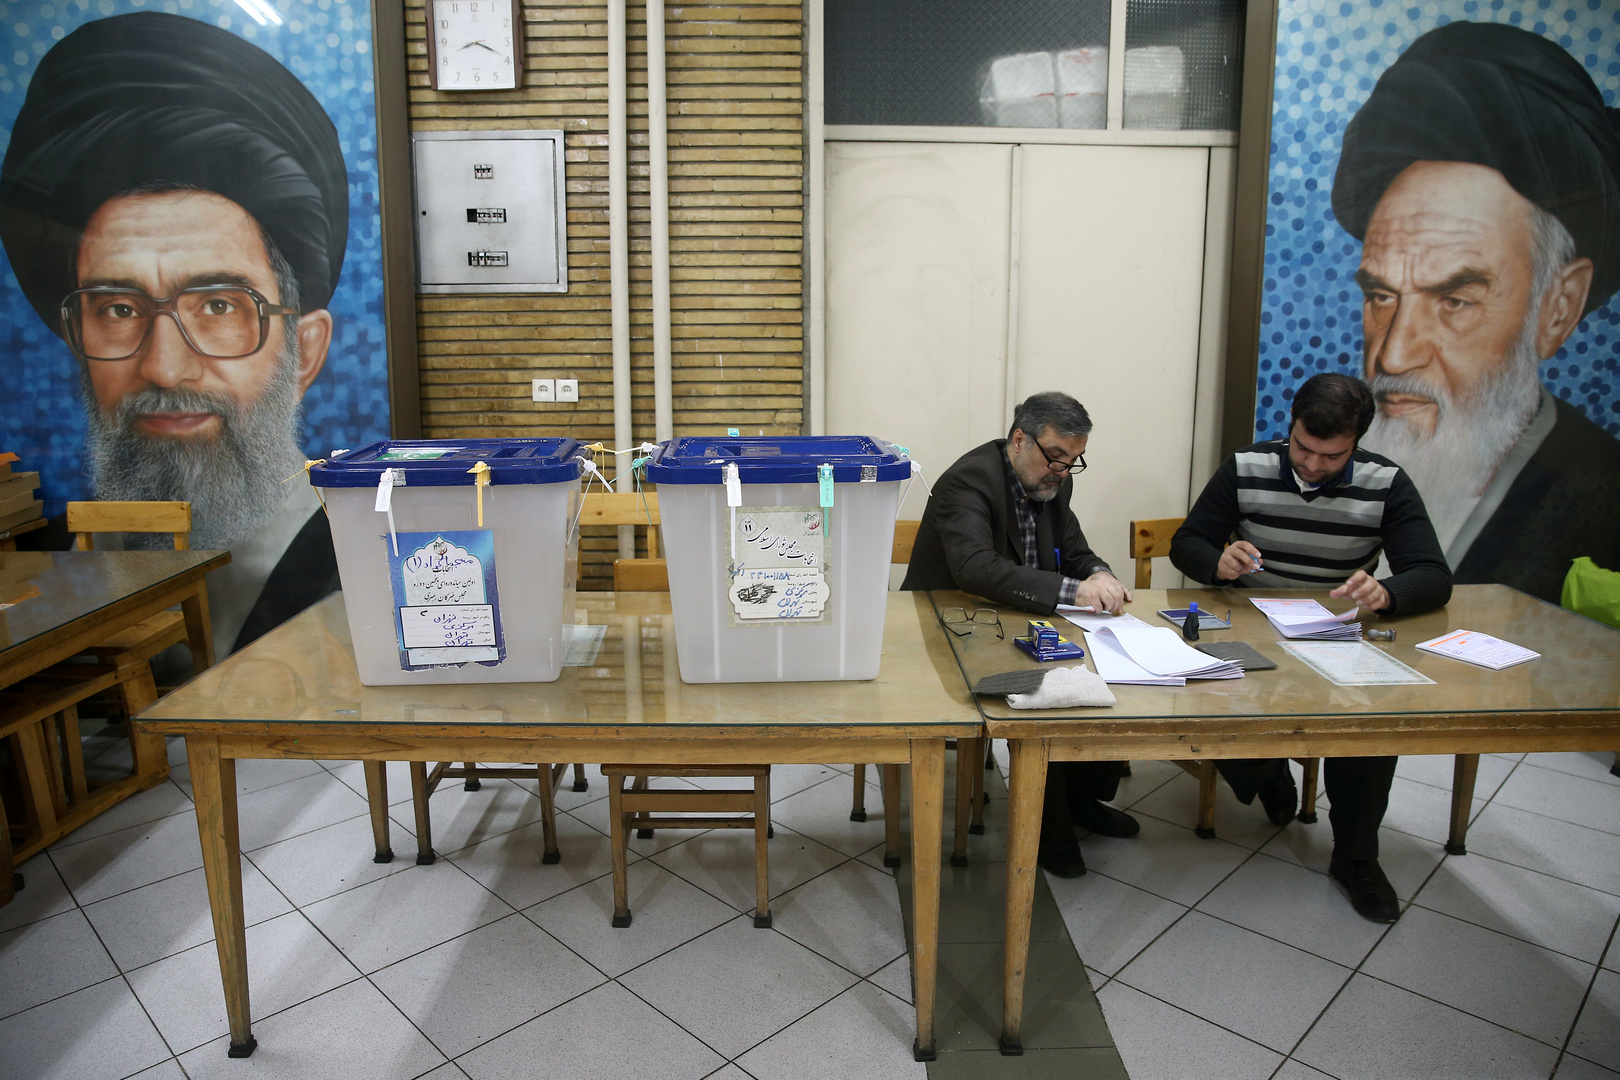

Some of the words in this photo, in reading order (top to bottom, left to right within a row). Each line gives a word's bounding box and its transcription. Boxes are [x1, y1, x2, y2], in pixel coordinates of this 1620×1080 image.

[452, 4, 458, 13] 11
[470, 3, 478, 12] 12
[441, 20, 449, 29] 10
[503, 18, 509, 28] 2
[441, 38, 448, 47] 9
[504, 37, 509, 47] 3
[442, 57, 448, 66] 8
[504, 56, 510, 65] 4
[456, 72, 461, 81] 7
[474, 73, 480, 82] 6
[493, 72, 499, 81] 5
[747, 527, 772, 542] اسلامی
[760, 536, 787, 550] شورای
[779, 541, 796, 556] مجلس
[787, 551, 816, 565] انتخابات
[462, 577, 476, 587] اولین
[424, 592, 437, 602] رهبری
[437, 592, 455, 602] خبرگان
[454, 590, 467, 602] مجلس
